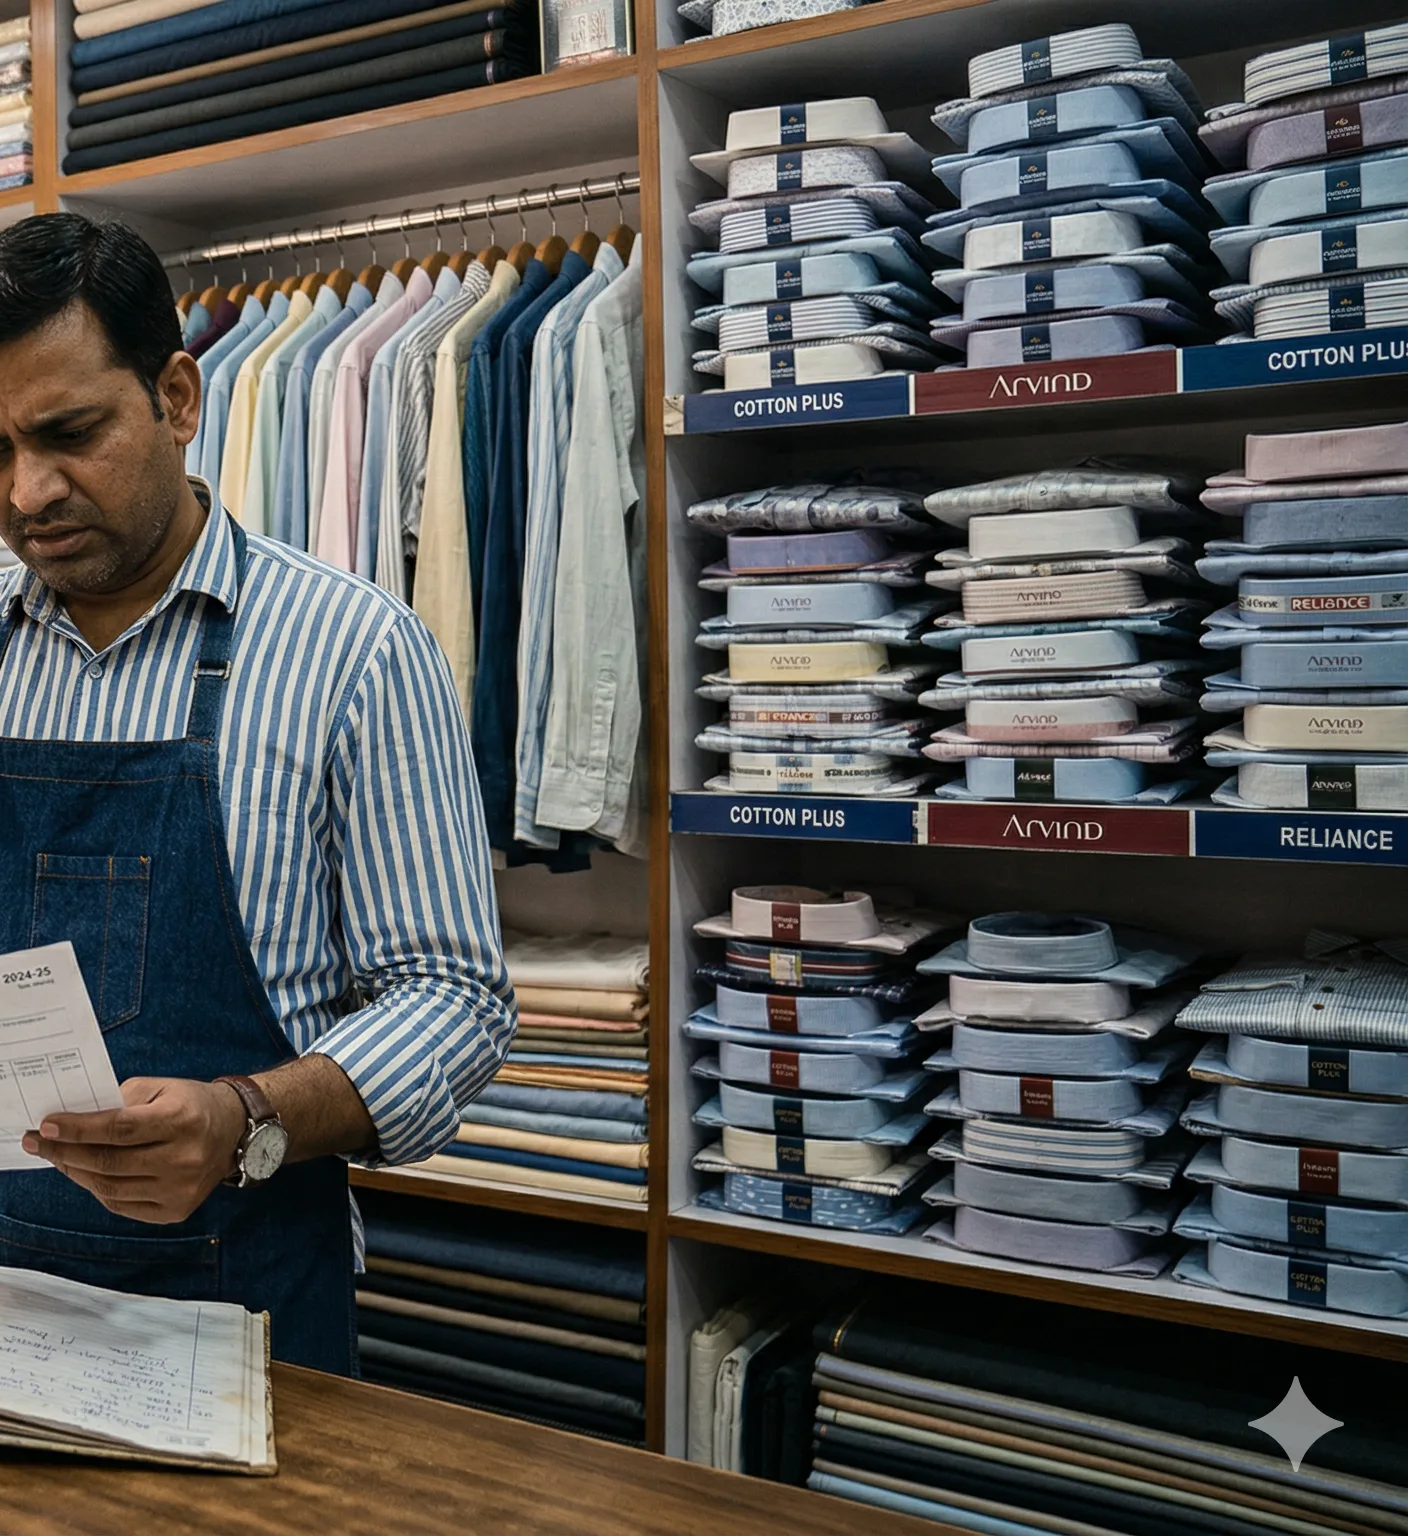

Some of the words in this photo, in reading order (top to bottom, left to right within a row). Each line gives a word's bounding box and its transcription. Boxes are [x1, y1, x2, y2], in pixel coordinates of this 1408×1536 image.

[1267, 345, 1355, 372] COTTON
[1361, 340, 1408, 363] PLU
[733, 395, 798, 419] COTTON
[801, 391, 844, 413] PLUS
[729, 805, 797, 826] COTTON
[801, 806, 846, 828] PLUS
[1280, 825, 1394, 852] RELIANCE
[2, 966, 52, 985] 2024-25
